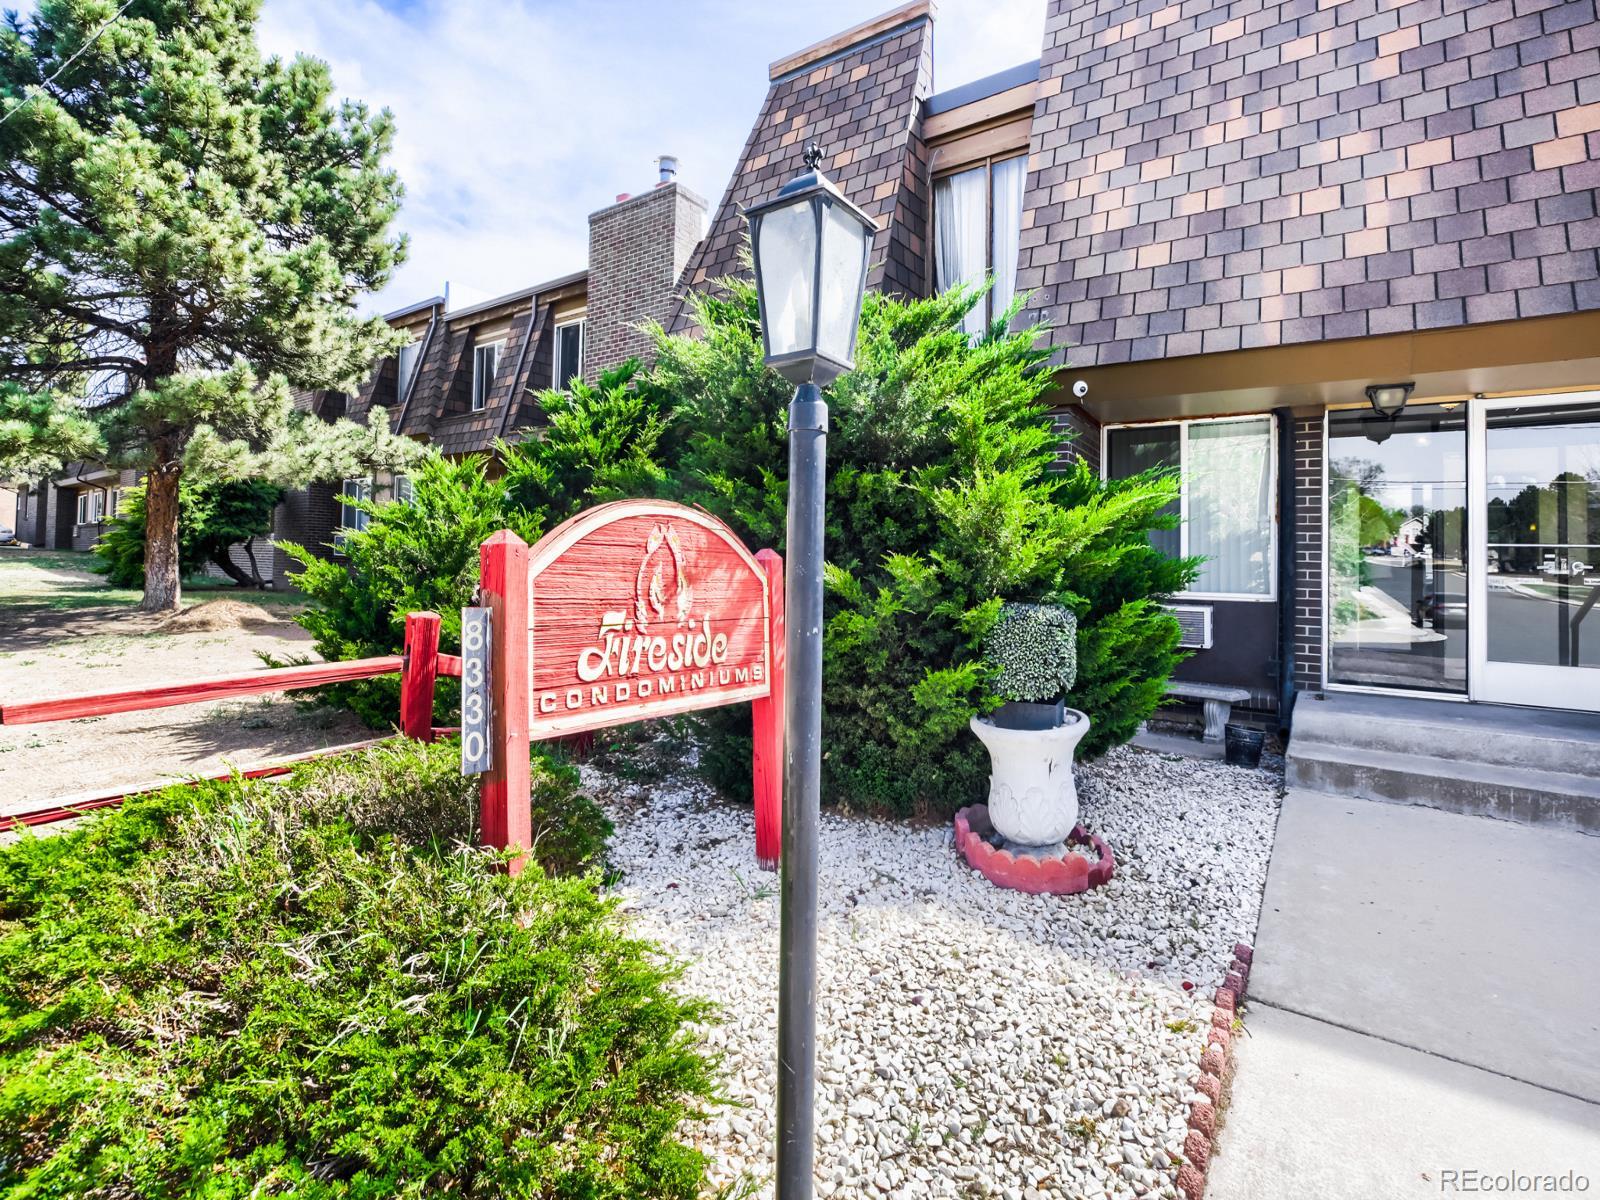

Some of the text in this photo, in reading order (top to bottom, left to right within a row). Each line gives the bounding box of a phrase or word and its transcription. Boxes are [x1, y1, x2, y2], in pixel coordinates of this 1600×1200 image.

[577, 609, 728, 682] Fireside
[465, 620, 484, 762] 8330
[539, 666, 764, 713] CONDOMINIUMS
